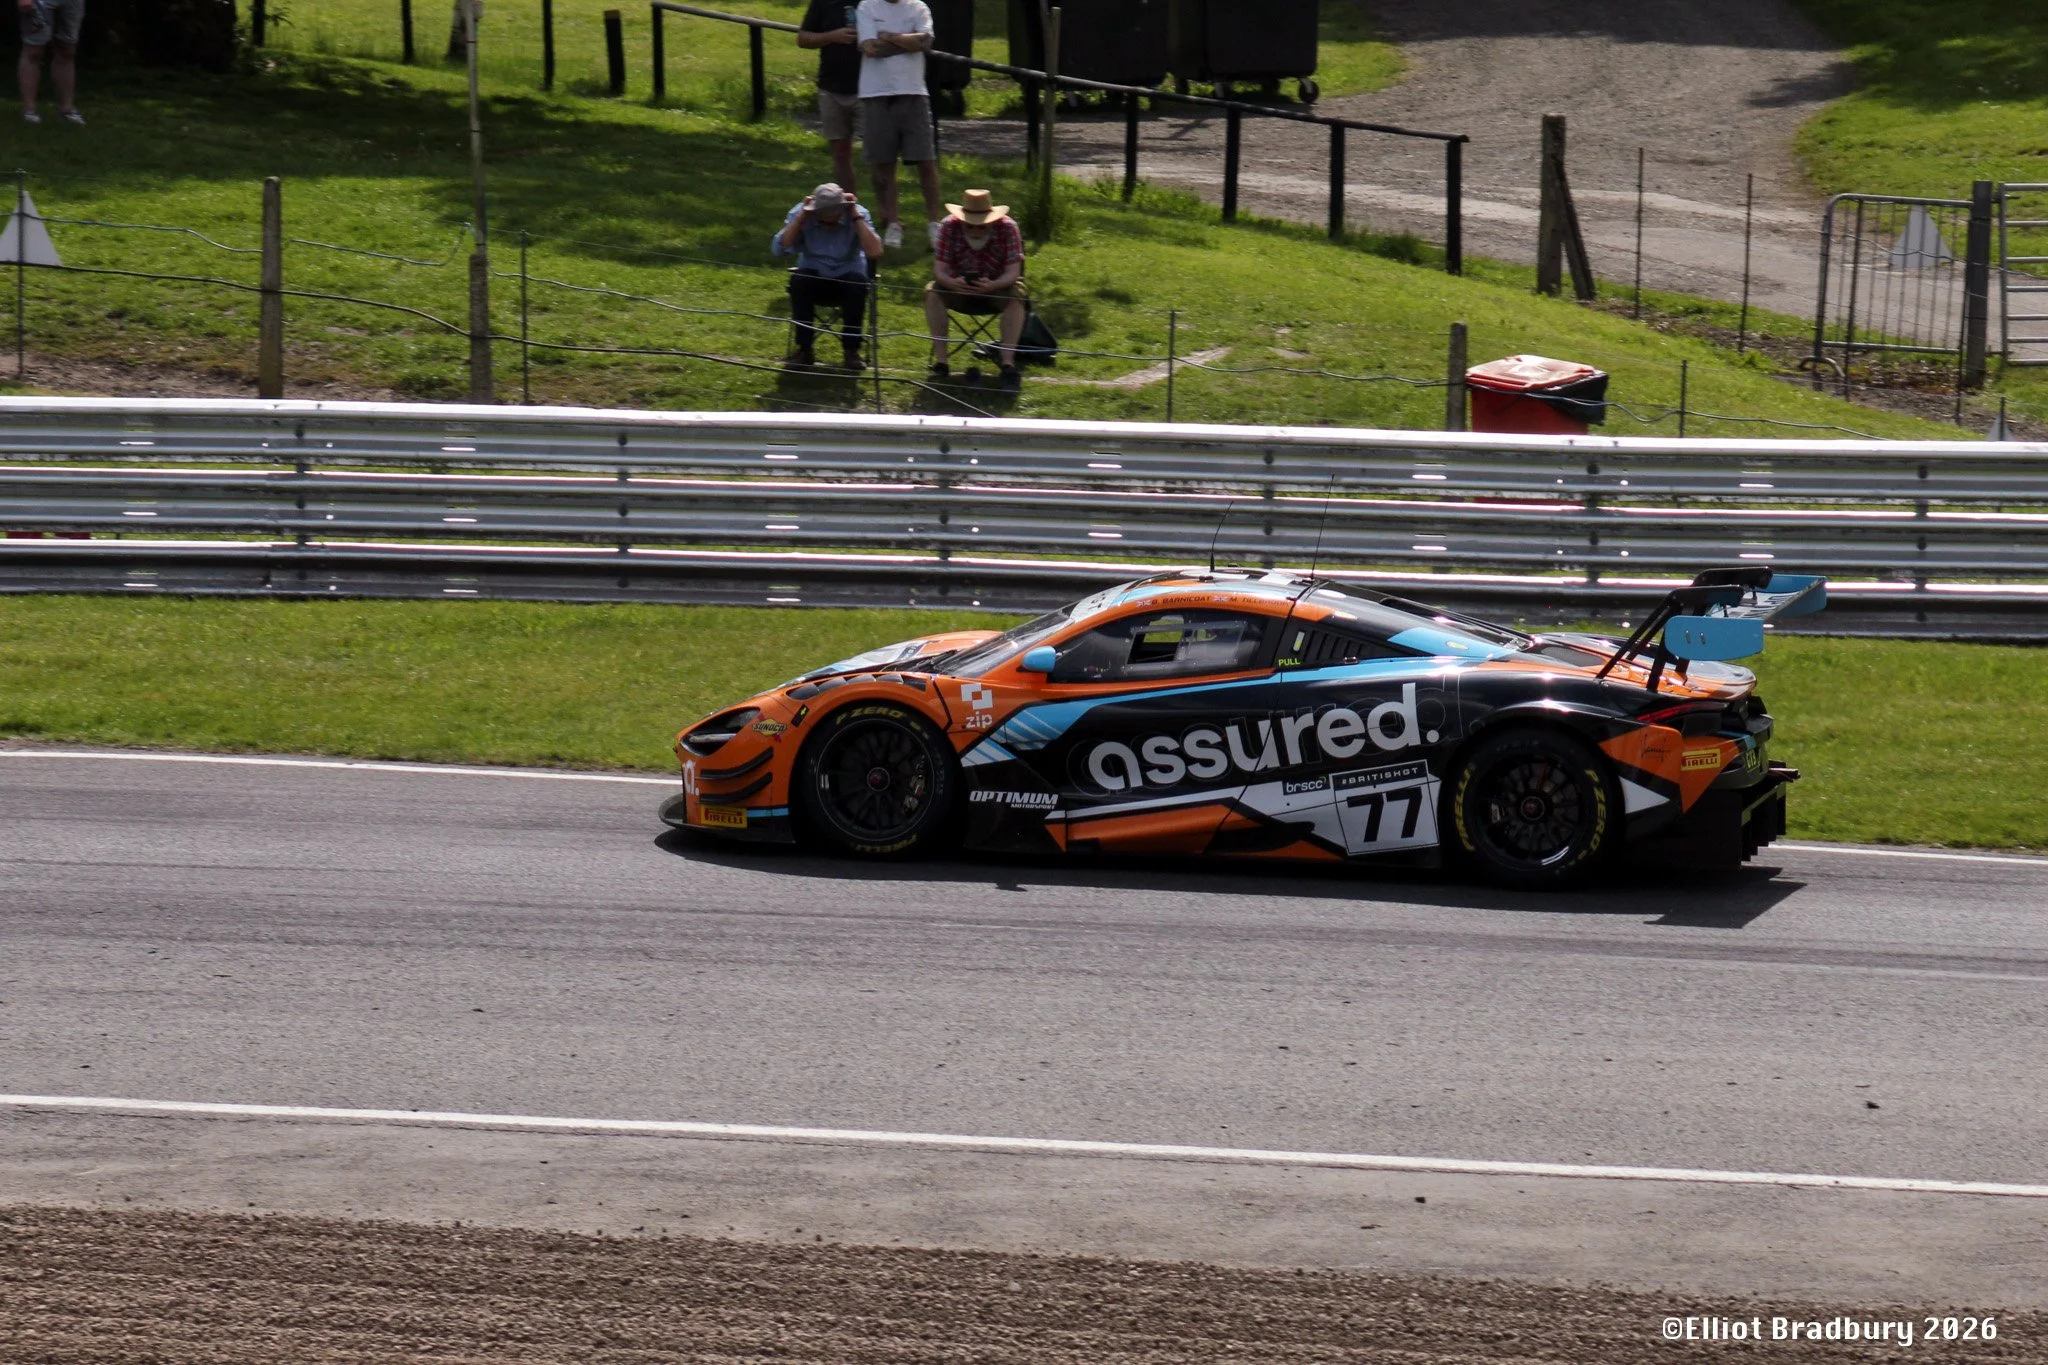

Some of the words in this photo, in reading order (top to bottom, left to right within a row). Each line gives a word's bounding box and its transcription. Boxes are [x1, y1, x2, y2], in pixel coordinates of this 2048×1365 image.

[1278, 658, 1300, 666] PULL
[850, 706, 906, 719] ZERO
[966, 711, 993, 729] zip
[753, 722, 786, 732] SUNOCO
[1087, 682, 1440, 791] assured.
[1681, 753, 1718, 767] PIRELLI
[1341, 767, 1419, 785] #BRITISHGT
[1286, 778, 1324, 793] brscc
[969, 790, 1059, 805] OPTIMUM
[704, 807, 743, 824] PIRELLI
[1347, 786, 1423, 843] 77
